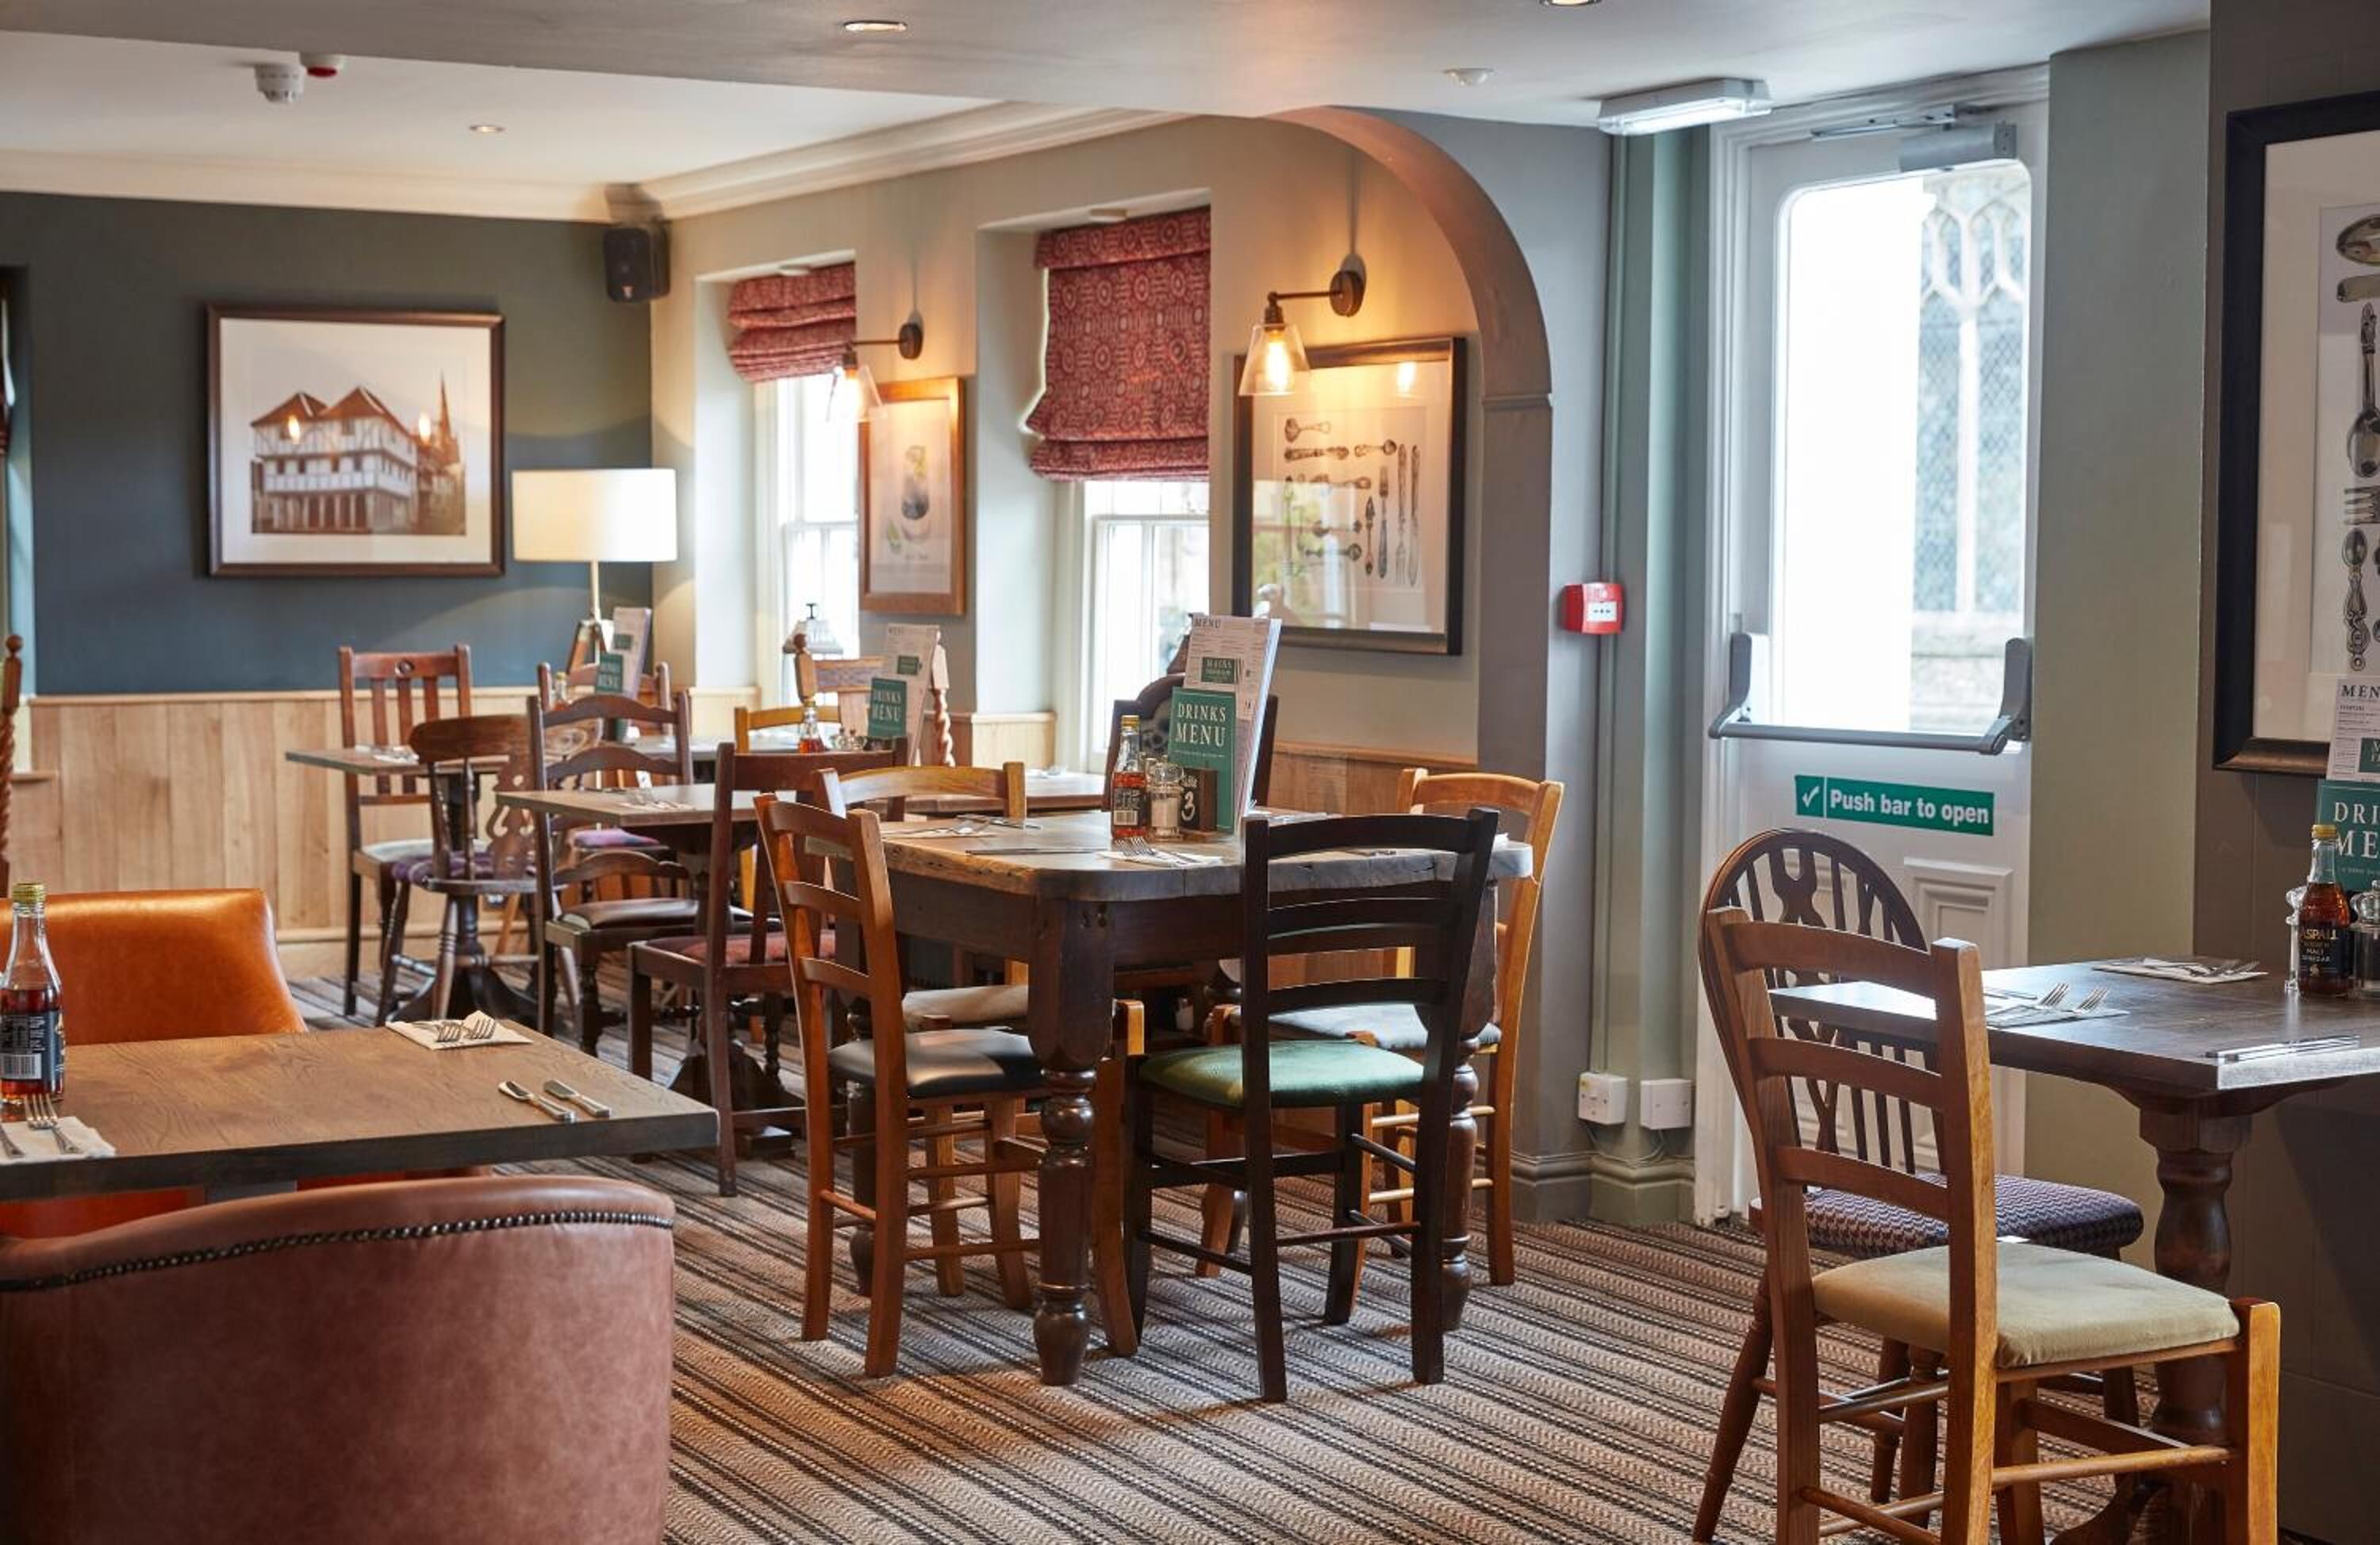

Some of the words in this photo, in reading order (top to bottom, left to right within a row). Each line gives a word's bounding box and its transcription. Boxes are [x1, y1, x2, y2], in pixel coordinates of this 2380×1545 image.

[1193, 618, 1220, 629] MENU
[2341, 684, 2380, 698] MEN
[1178, 703, 1226, 723] DRINKS
[1175, 723, 1226, 747] MENU
[1181, 791, 1196, 821] 3
[1830, 789, 1875, 812] Push
[1880, 794, 1912, 816] bar
[1917, 797, 1936, 819] to
[1941, 803, 1989, 826] open
